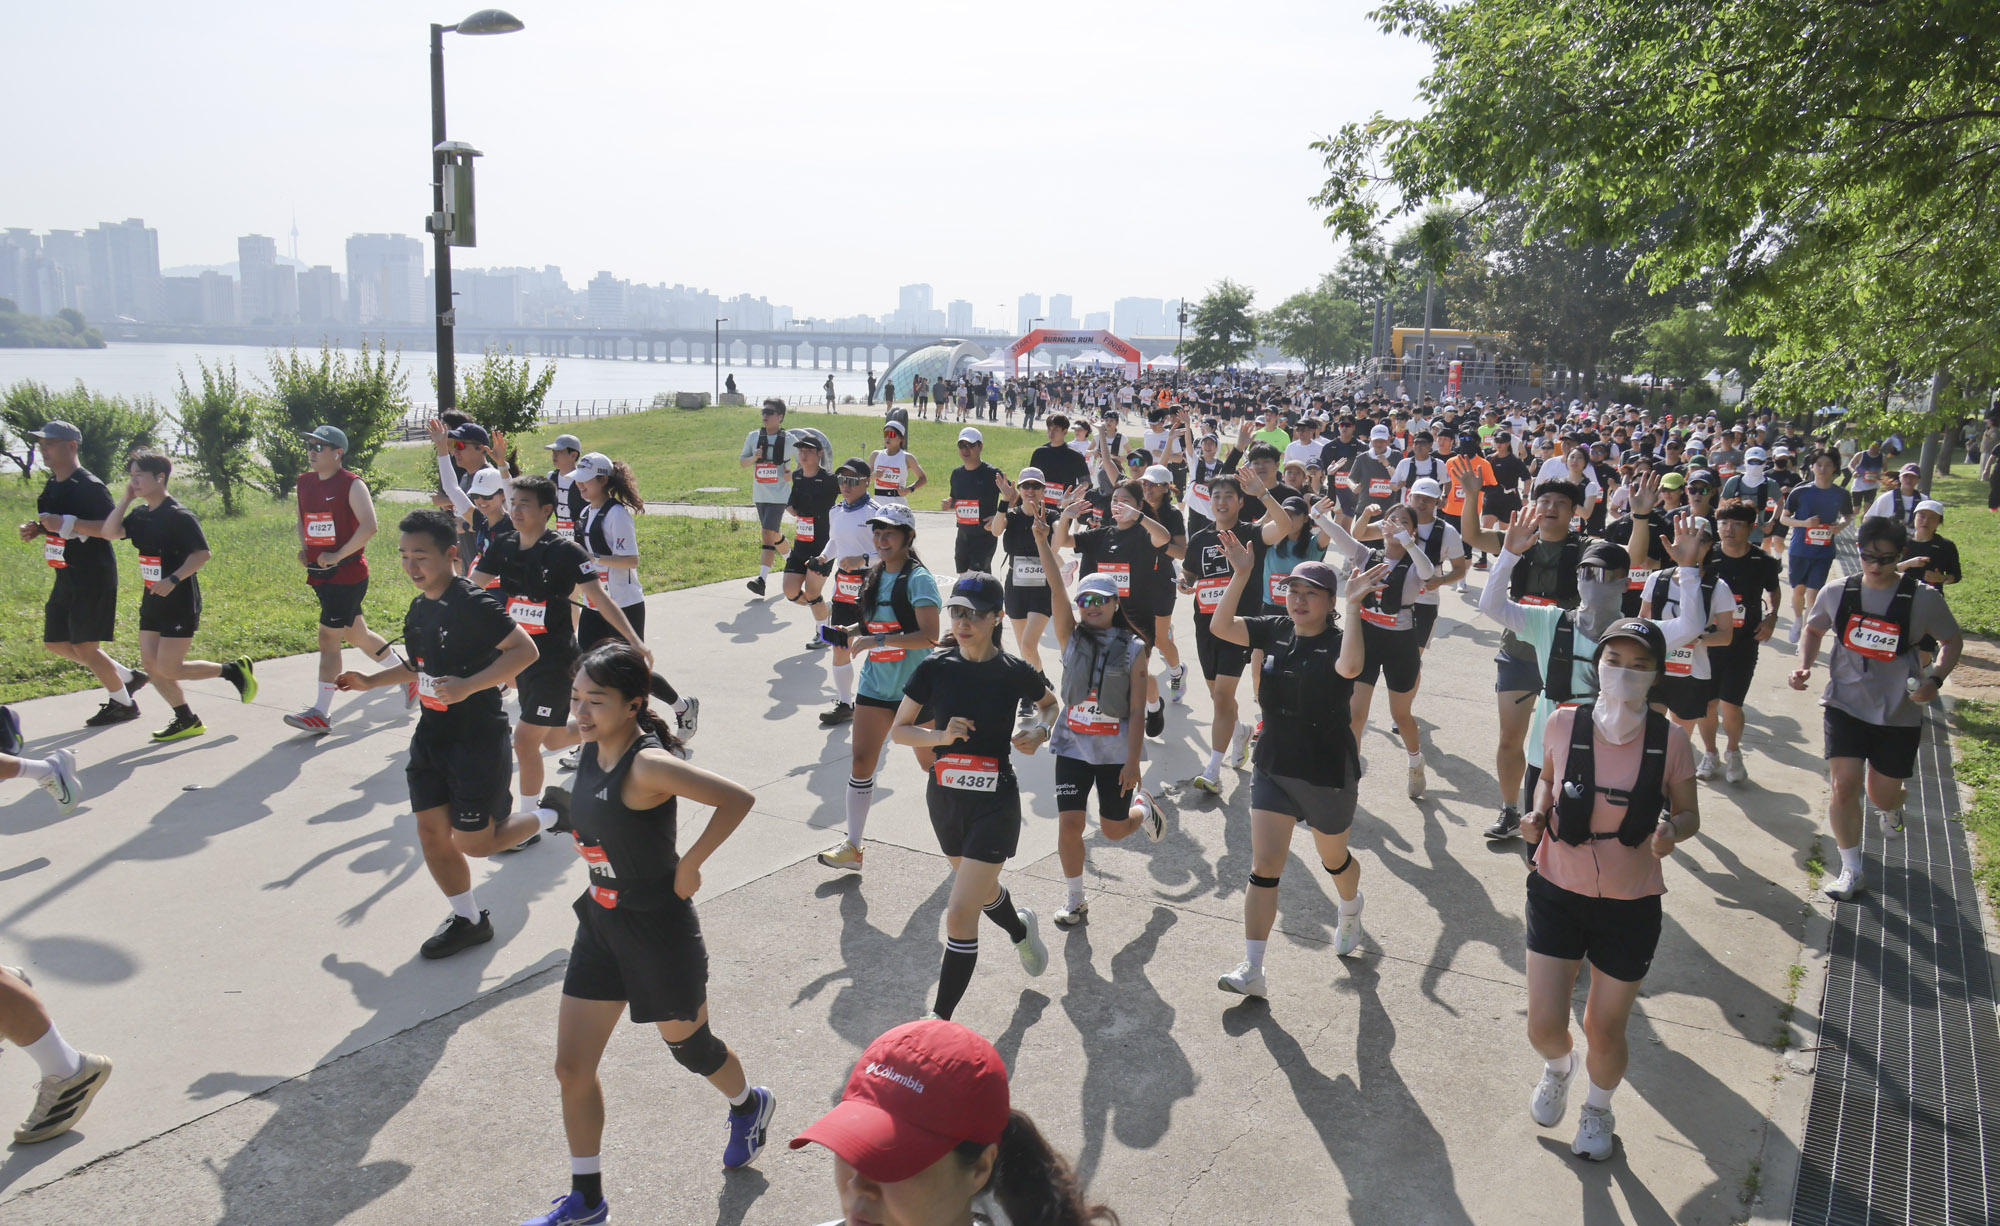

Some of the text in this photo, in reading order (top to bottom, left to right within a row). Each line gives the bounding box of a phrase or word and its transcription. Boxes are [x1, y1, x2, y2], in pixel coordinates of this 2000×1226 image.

[1012, 335, 1032, 353] START
[1103, 336, 1128, 355] FINISH
[1208, 589, 1224, 599] 154
[518, 607, 544, 619] 1144
[1865, 632, 1896, 646] 1042
[1077, 705, 1085, 713] W
[945, 775, 996, 789] W 4387
[874, 1063, 925, 1094] Columbia
